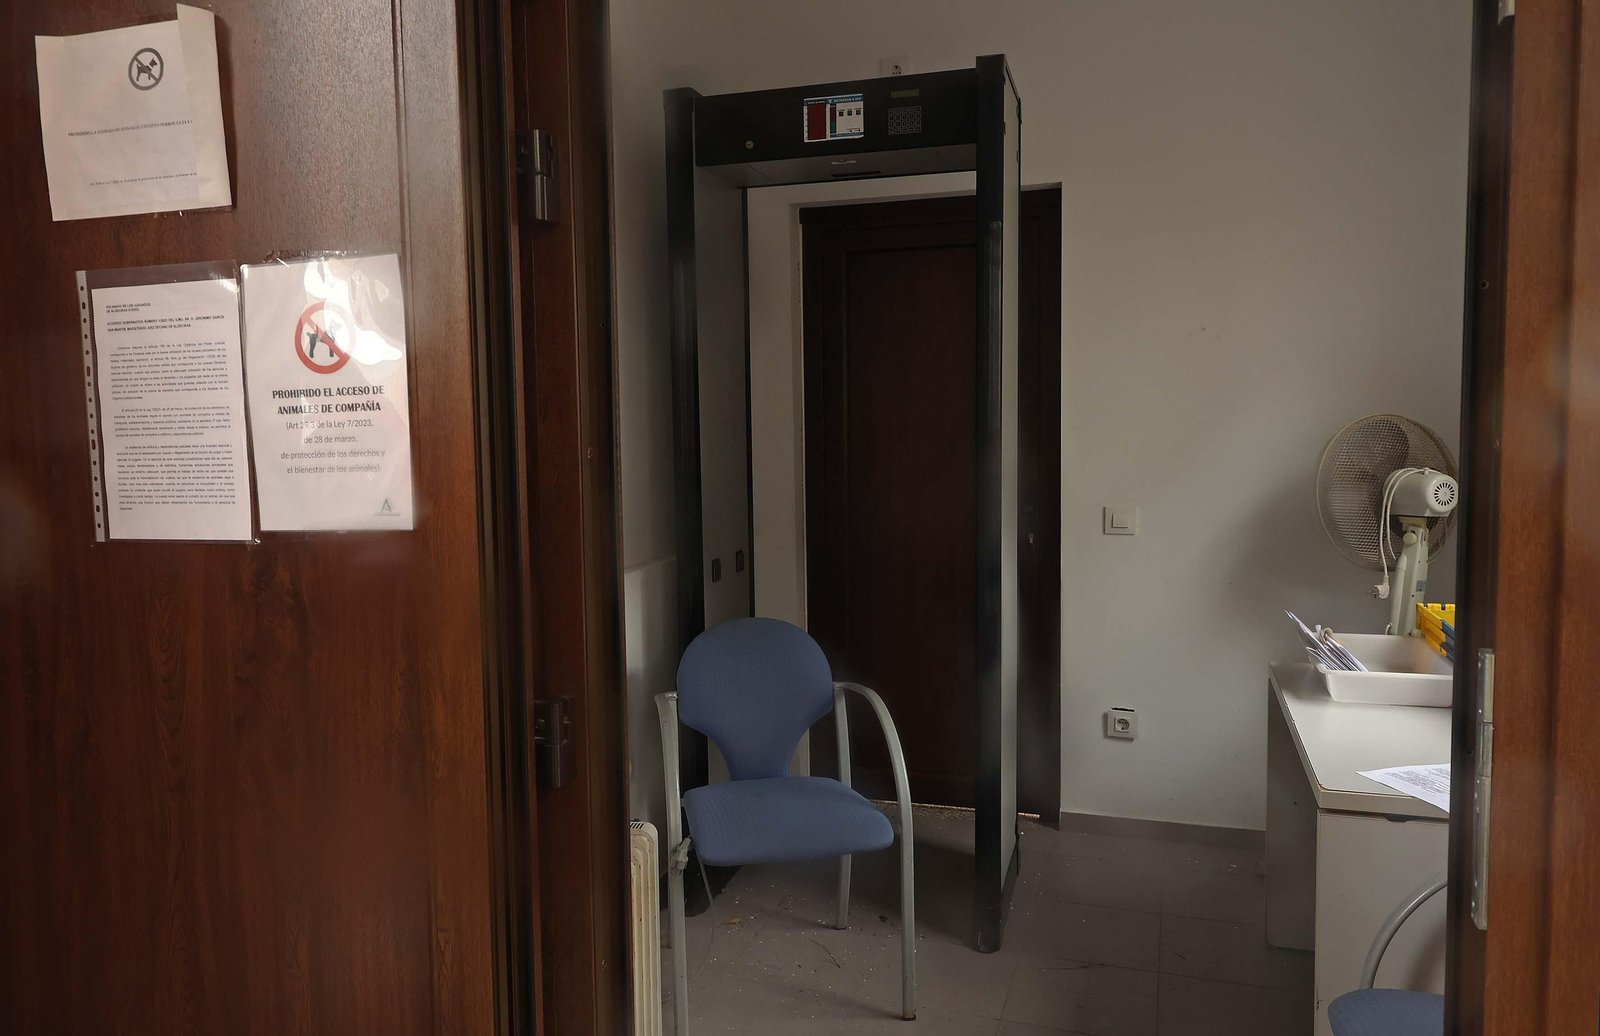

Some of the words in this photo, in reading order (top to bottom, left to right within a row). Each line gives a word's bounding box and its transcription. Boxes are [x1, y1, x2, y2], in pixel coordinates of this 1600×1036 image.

[272, 388, 321, 399] PROHIBIDO
[323, 388, 334, 397] EL
[336, 386, 370, 396] ACCESO
[372, 385, 385, 395] DE
[277, 405, 319, 415] ANIMALES
[321, 404, 333, 413] DE
[335, 400, 382, 412] COMPAÑÍA
[286, 422, 299, 430] (Art
[317, 420, 325, 428] de
[326, 420, 333, 428] la
[334, 420, 346, 429] Ley
[304, 436, 312, 444] de
[314, 436, 323, 444] 28
[324, 435, 333, 443] de
[280, 452, 290, 460] de
[290, 451, 326, 460] protección
[327, 450, 336, 458] de
[337, 450, 348, 458] los
[348, 449, 380, 458] derechos
[381, 450, 386, 458] y
[286, 466, 294, 474] el
[294, 466, 326, 474] bienestar
[327, 465, 336, 473] de
[337, 465, 347, 473] los
[348, 464, 380, 473] animales)
